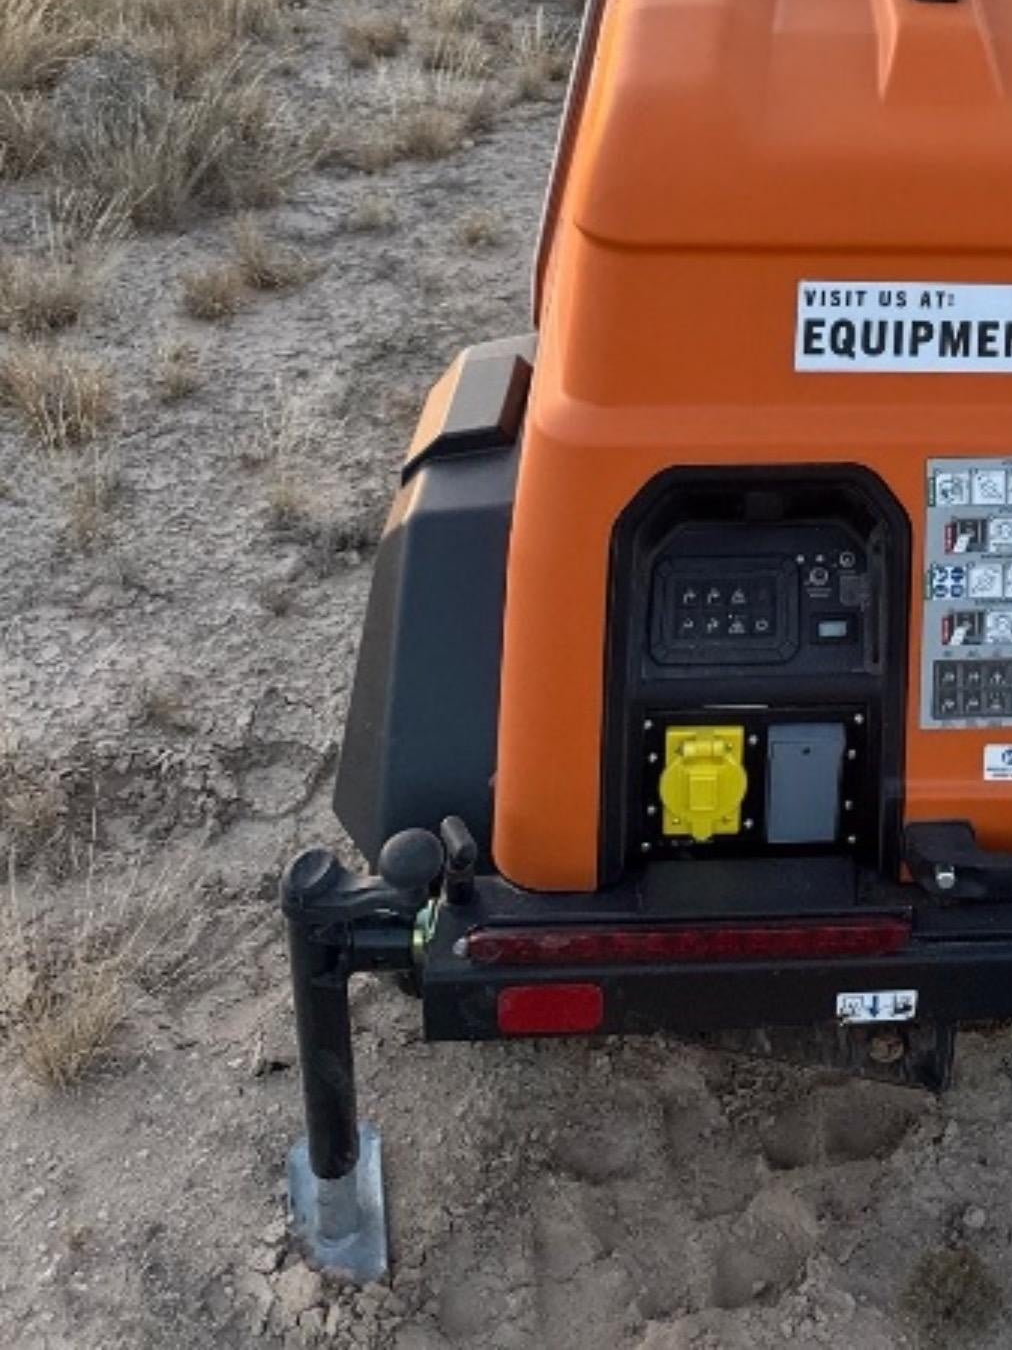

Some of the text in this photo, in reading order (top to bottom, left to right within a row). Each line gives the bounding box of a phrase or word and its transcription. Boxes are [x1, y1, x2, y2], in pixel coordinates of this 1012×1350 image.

[804, 289, 955, 309] VISIT US AT:
